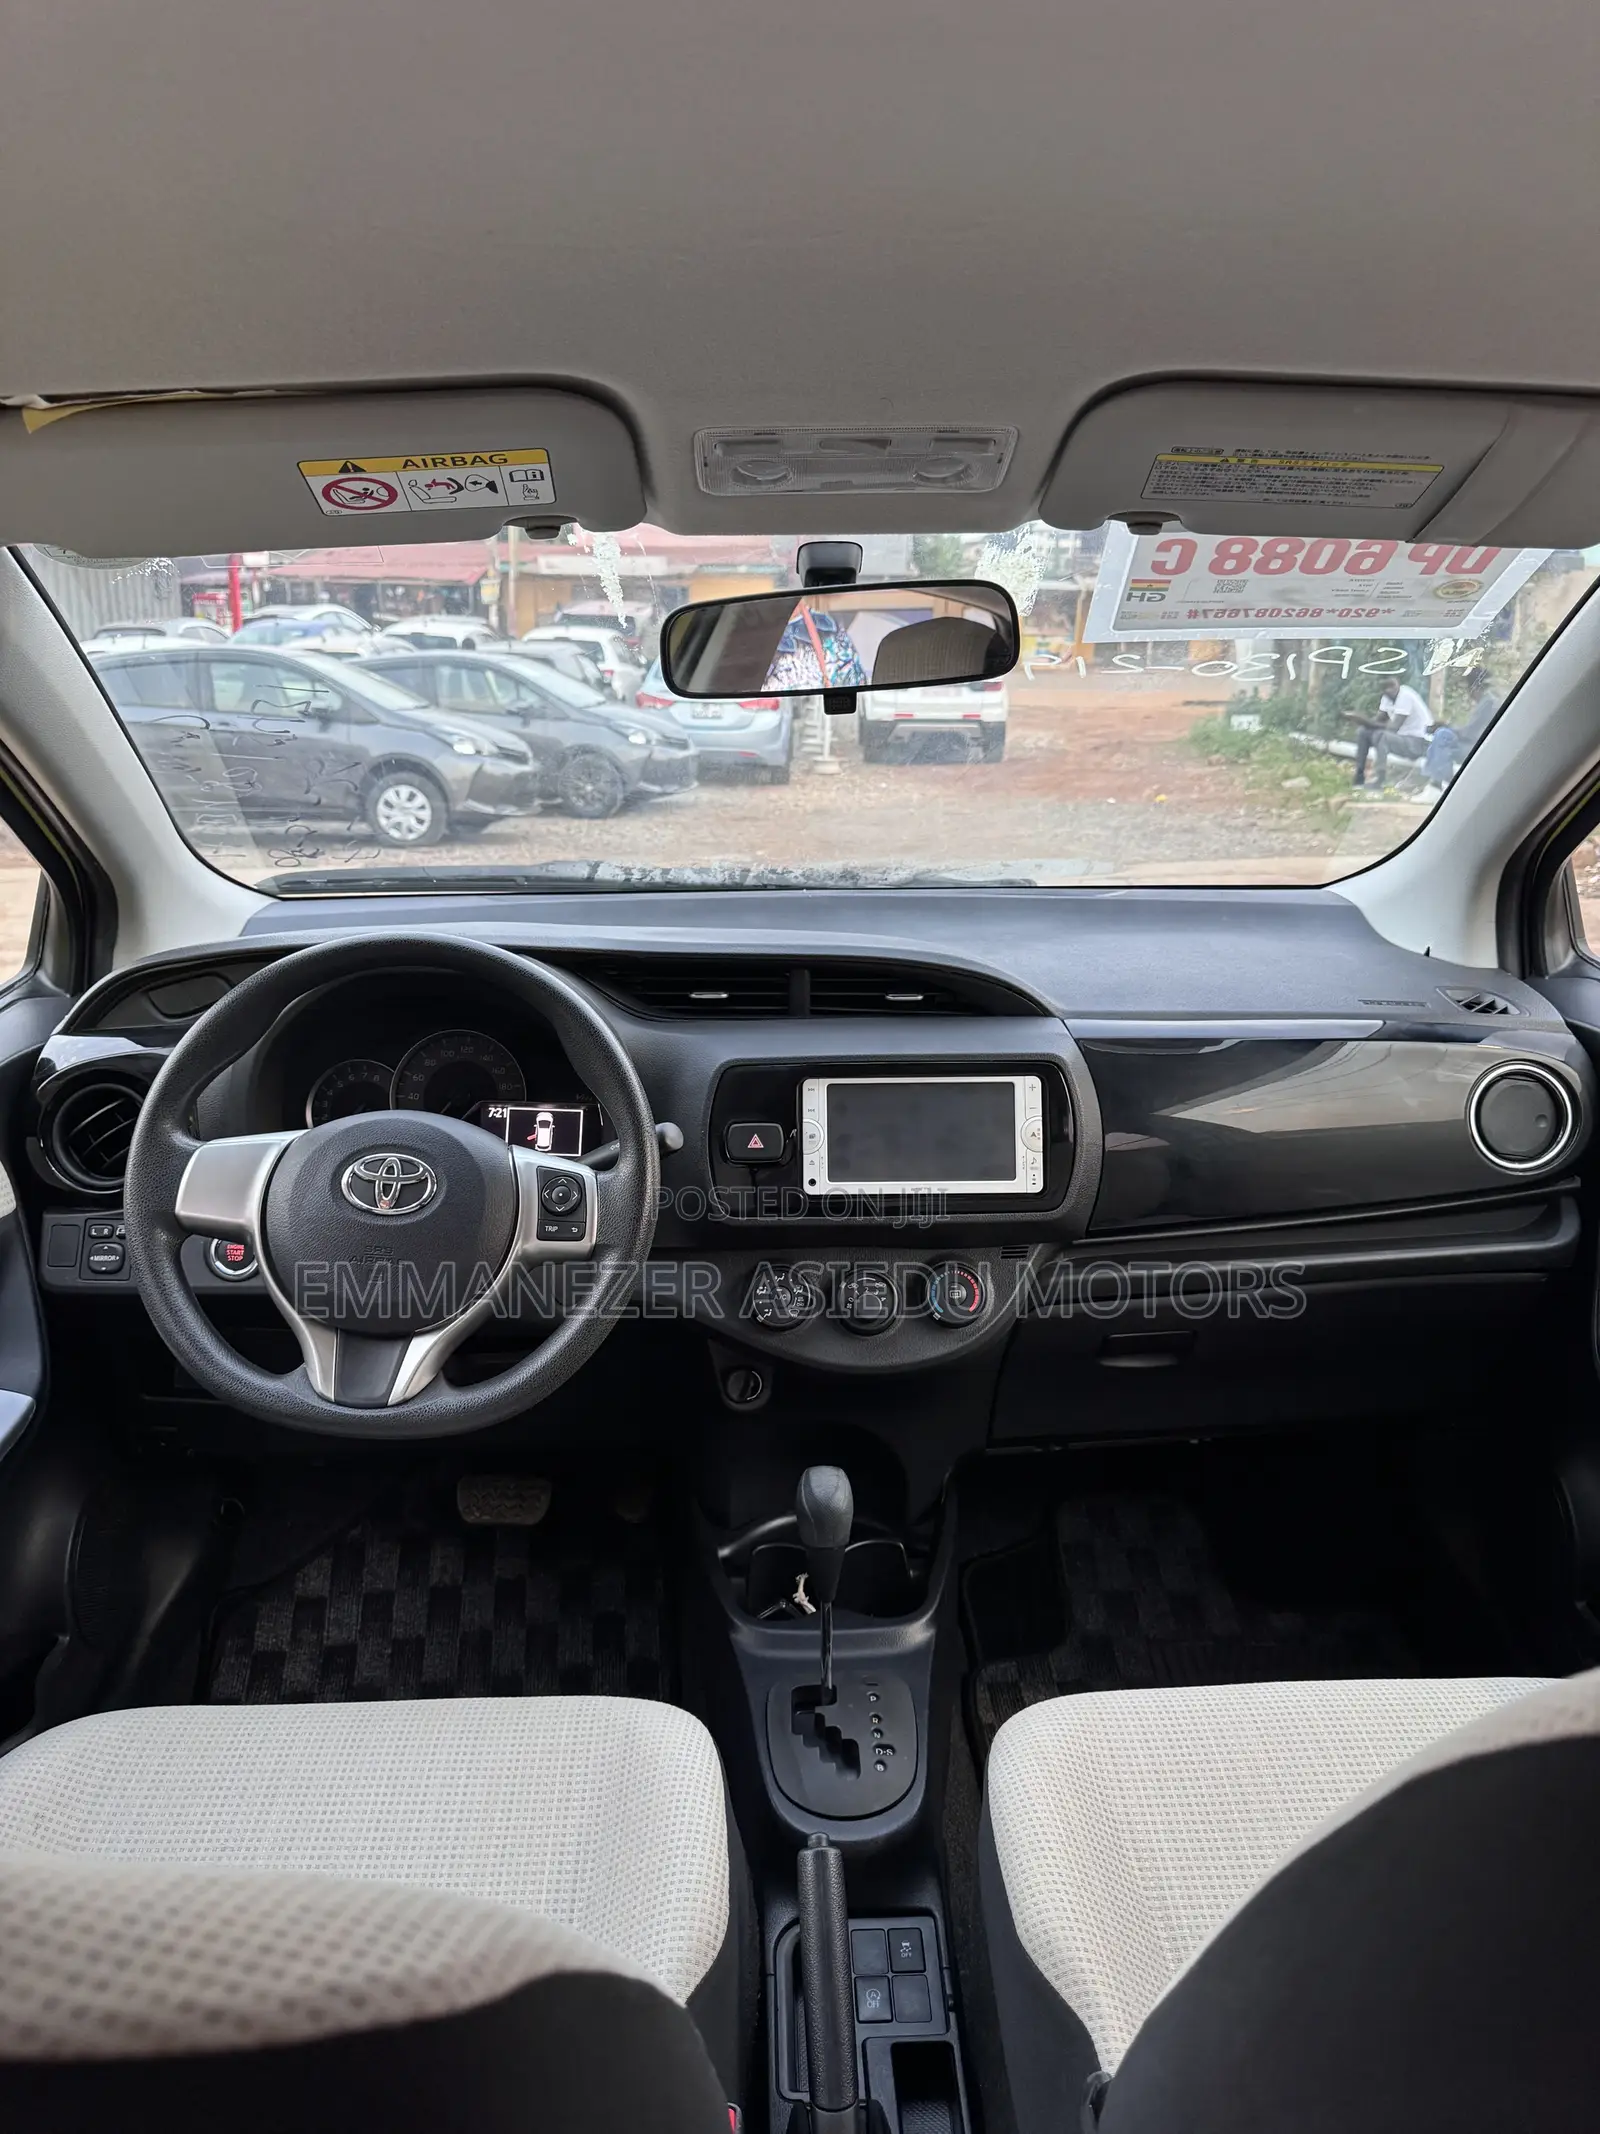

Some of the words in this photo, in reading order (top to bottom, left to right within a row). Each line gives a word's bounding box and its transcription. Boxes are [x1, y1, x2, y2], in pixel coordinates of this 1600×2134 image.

[402, 453, 509, 470] AIRBAG
[412, 1073, 425, 1082] 60
[408, 1092, 420, 1101] 40
[488, 1106, 507, 1119] 7:21
[544, 1224, 559, 1233] TRIP
[867, 2000, 881, 2008] OFF
